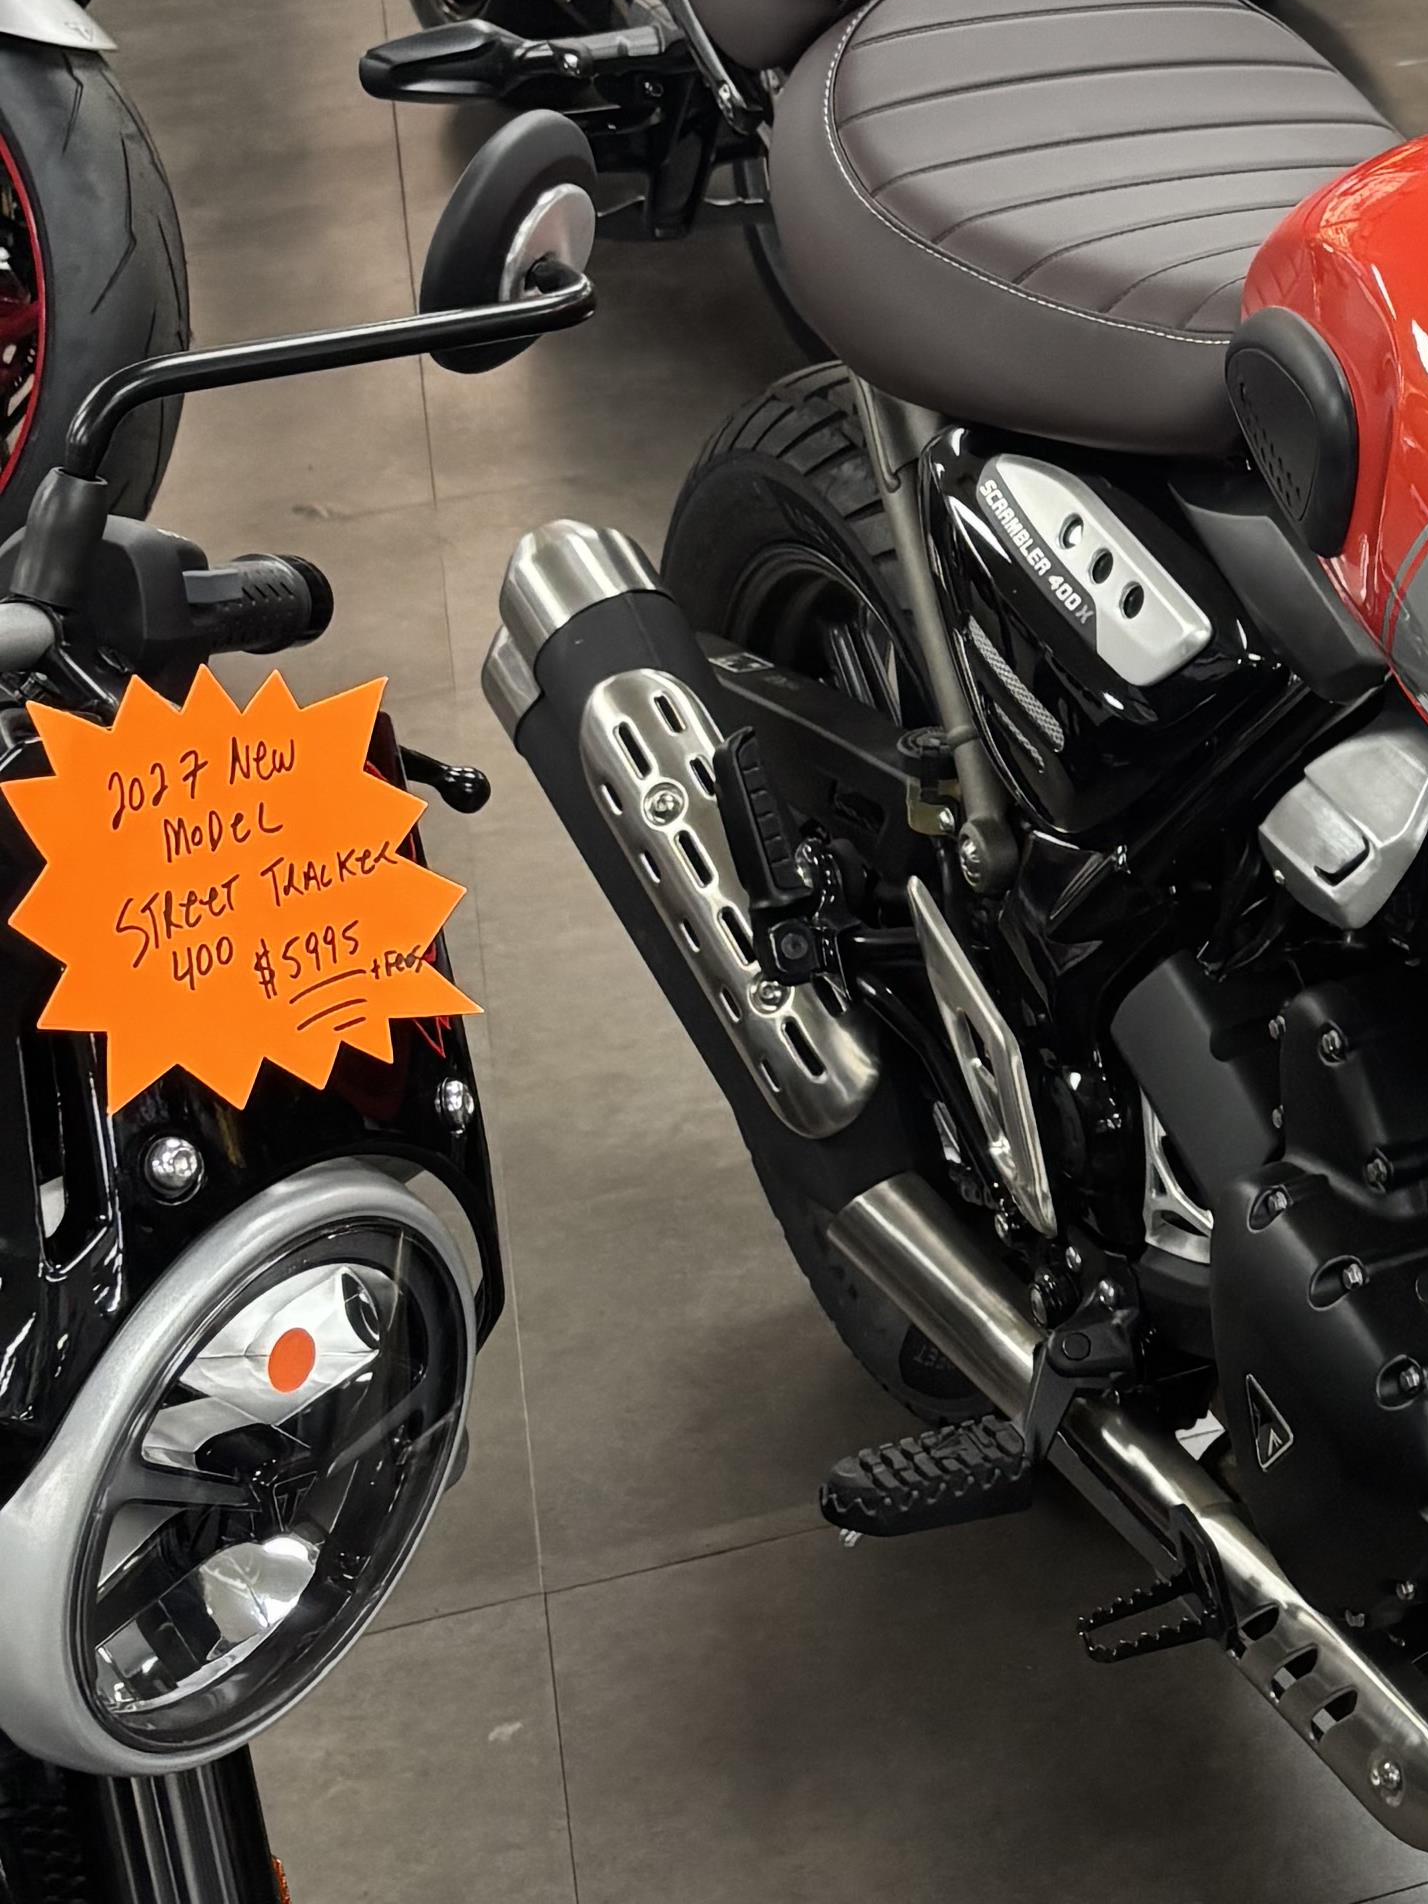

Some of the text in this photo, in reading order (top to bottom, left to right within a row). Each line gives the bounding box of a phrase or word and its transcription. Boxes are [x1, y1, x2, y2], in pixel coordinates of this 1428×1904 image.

[979, 479, 1094, 624] SCRAMBLER 400 X
[107, 749, 209, 831] 2027
[171, 935, 234, 991] 400
[253, 920, 360, 999] $5995
